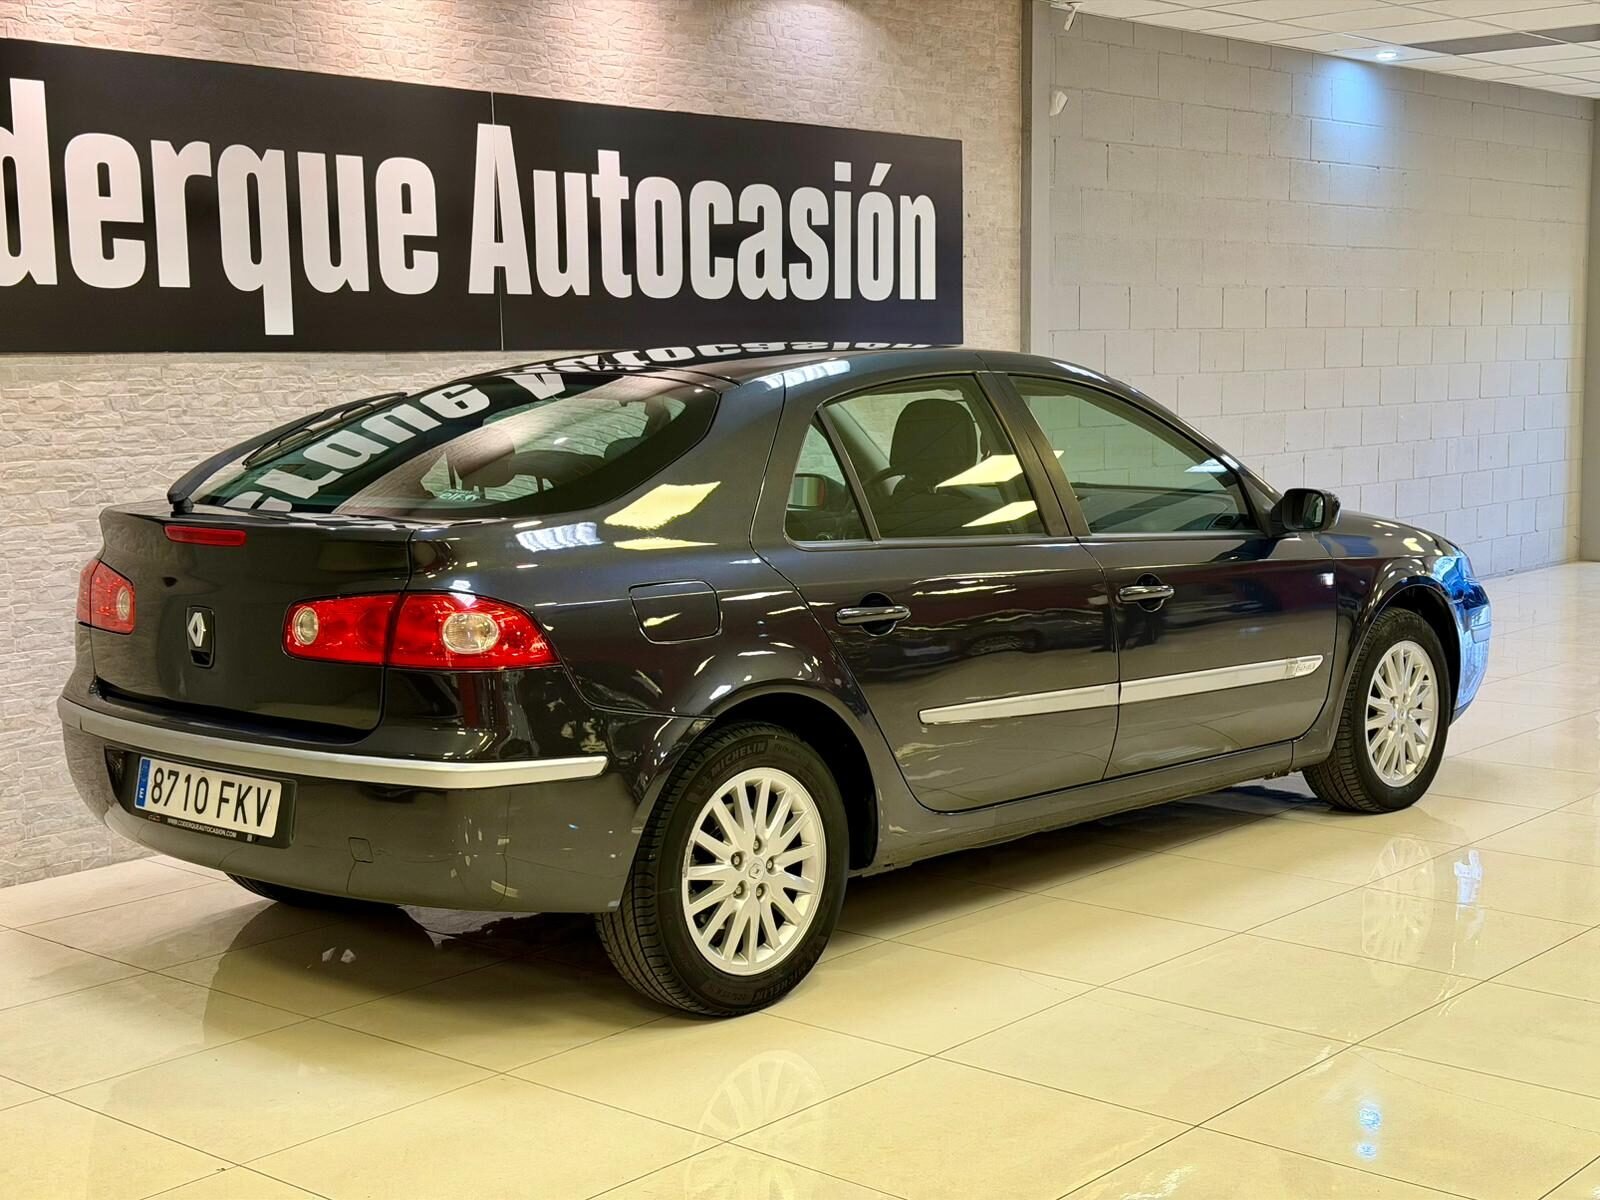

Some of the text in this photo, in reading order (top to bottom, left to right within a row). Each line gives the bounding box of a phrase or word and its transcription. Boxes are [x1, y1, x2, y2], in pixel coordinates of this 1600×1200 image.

[468, 123, 937, 301] Autocasión
[711, 741, 767, 777] MICHELIN
[151, 767, 272, 827] 8710 FKV
